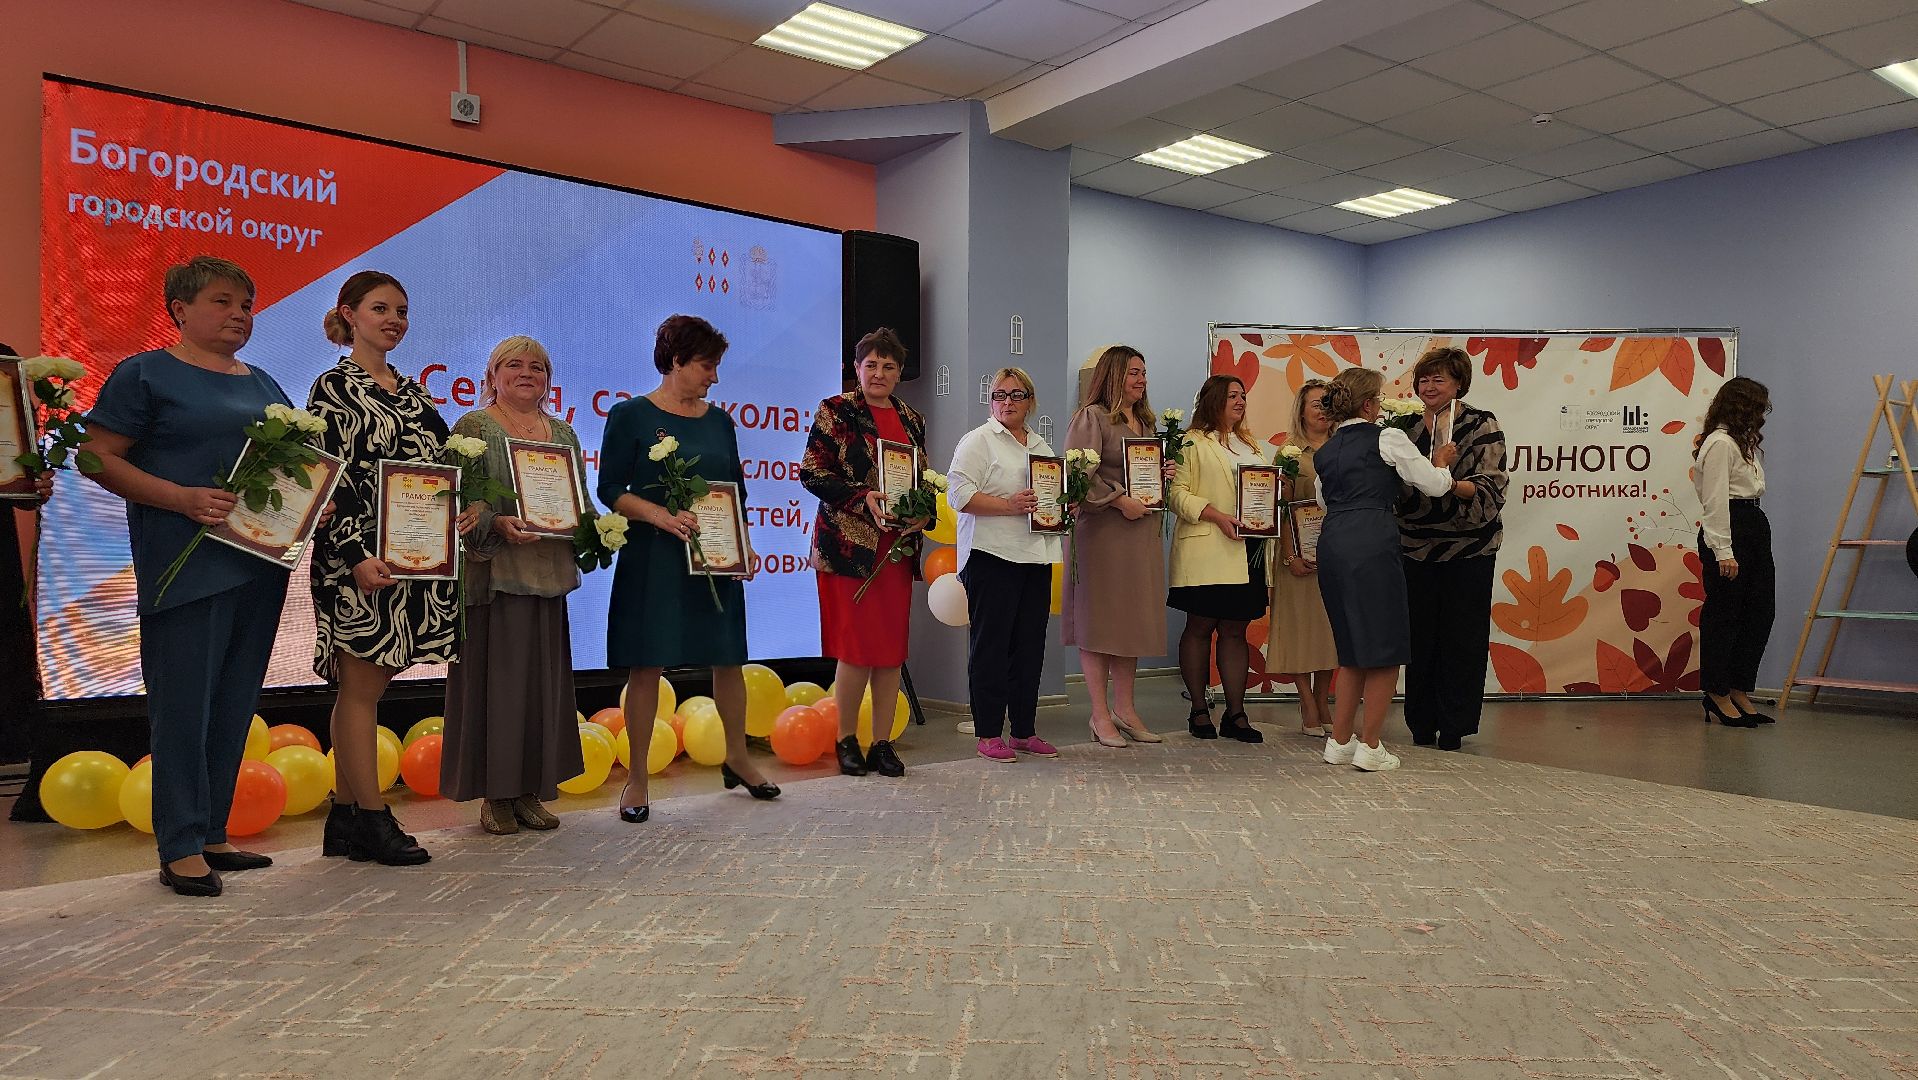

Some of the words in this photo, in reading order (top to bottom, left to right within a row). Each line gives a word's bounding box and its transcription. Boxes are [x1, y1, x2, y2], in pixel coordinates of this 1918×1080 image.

[69, 127, 338, 205] Богородский
[67, 191, 234, 235] городской
[241, 218, 323, 253] округ
[1508, 444, 1651, 473] ЛЬНОГО
[401, 492, 437, 502] ГРАМОТА
[1522, 479, 1648, 503] работника!
[746, 500, 810, 535] стей,
